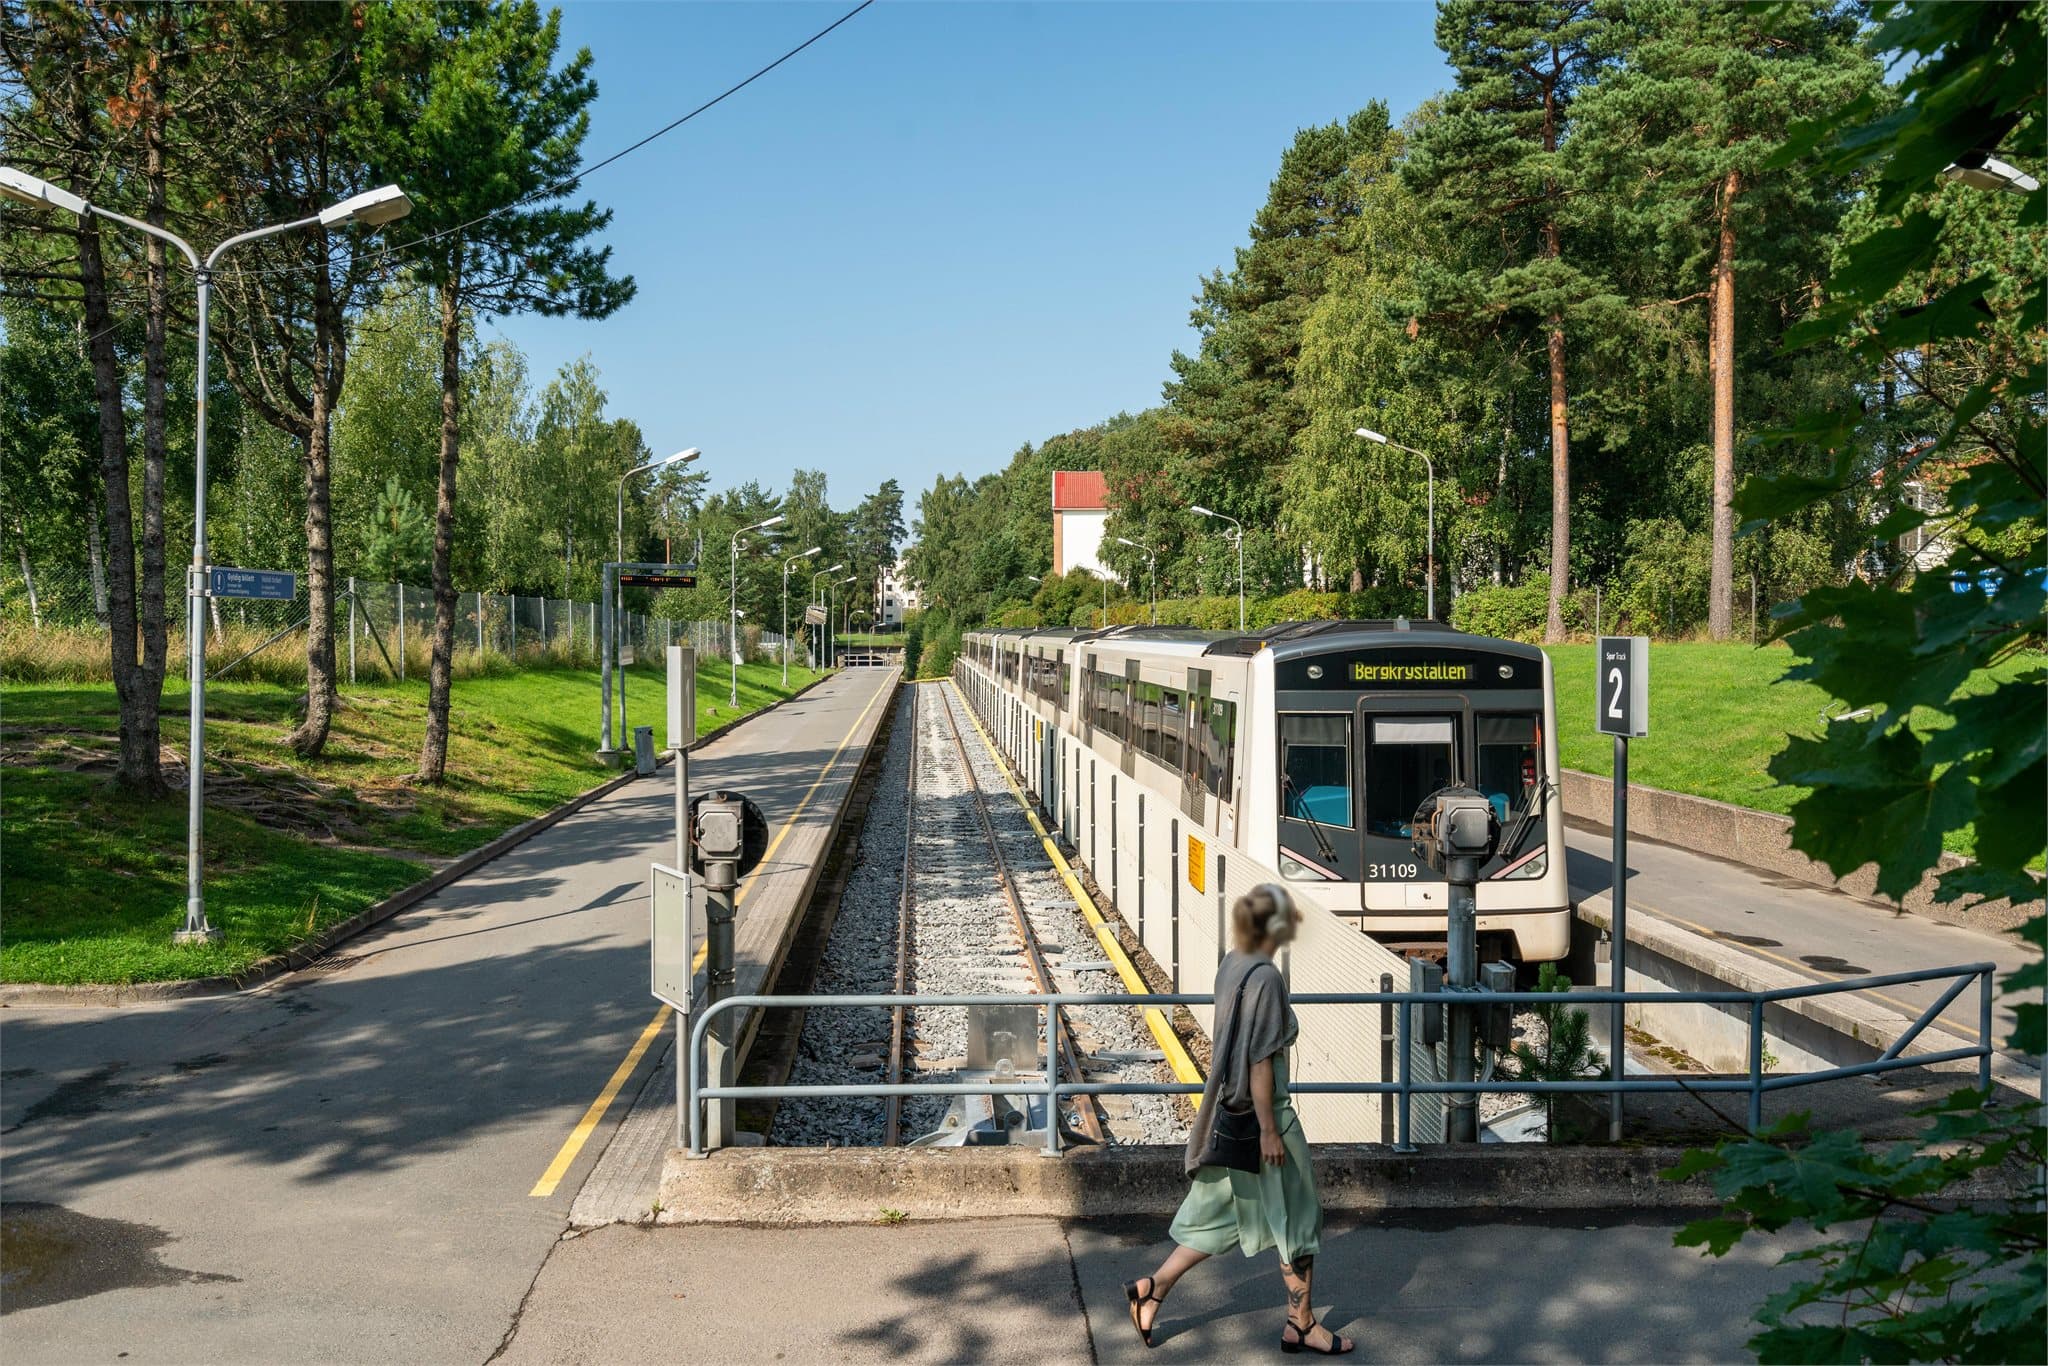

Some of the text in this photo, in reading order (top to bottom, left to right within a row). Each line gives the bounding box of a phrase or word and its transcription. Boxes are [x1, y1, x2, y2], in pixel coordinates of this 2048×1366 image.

[1355, 661, 1466, 680] Bergkrystallen
[1608, 667, 1623, 719] 2
[1369, 864, 1417, 878] 31109
